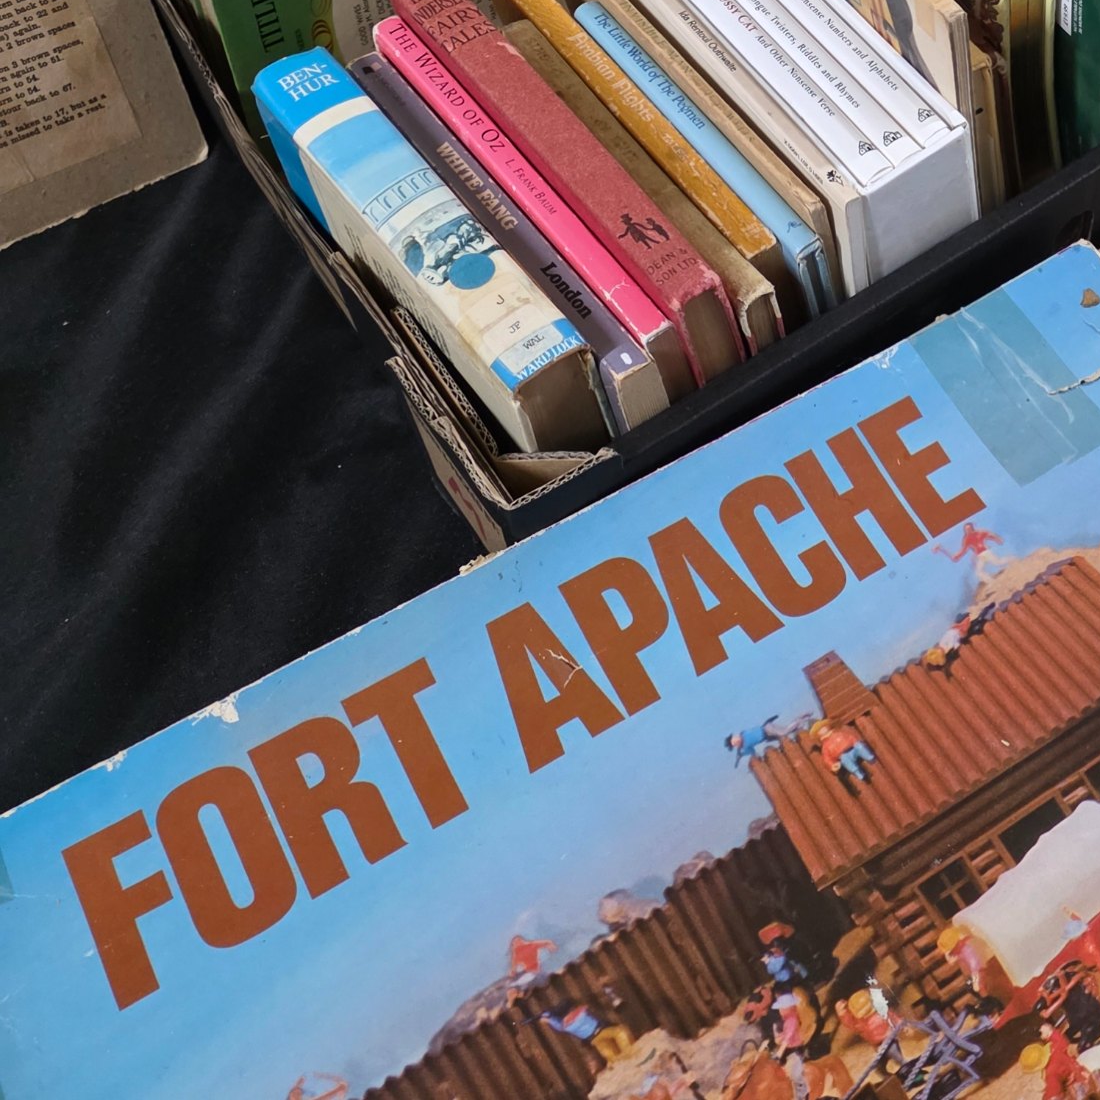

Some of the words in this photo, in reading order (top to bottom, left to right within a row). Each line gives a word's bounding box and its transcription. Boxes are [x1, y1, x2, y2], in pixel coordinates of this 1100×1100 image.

[51, 1, 70, 14] and
[426, 5, 484, 42] FAIRY
[16, 31, 45, 47] brown
[440, 19, 498, 54] TALES
[677, 9, 690, 23] Ida
[687, 18, 711, 45] Rentoul
[707, 39, 738, 73] Outhwaite
[20, 50, 51, 66] brown
[566, 31, 617, 80] Arabian
[594, 12, 611, 31] The
[607, 26, 632, 52] Little
[627, 43, 654, 73] World
[648, 65, 662, 83] of
[657, 75, 677, 97] The
[673, 93, 706, 131] Pegmen
[737, 13, 758, 34] CAT
[754, 33, 771, 49] And
[767, 46, 789, 70] Other
[786, 66, 818, 100] Nonsense
[817, 97, 837, 118] Verse
[769, 14, 797, 45] Twisters,
[796, 42, 823, 70] Riddles
[820, 67, 836, 84] and
[833, 80, 862, 110] Rhymes
[823, 17, 853, 50] Numbers
[851, 45, 868, 61] and
[865, 58, 900, 93] Alphabets
[276, 61, 330, 92] BEN-
[286, 73, 341, 103] HUR
[25, 94, 48, 107] back
[386, 21, 418, 54] THE
[413, 52, 466, 110] WIZARD
[462, 107, 485, 131] OF
[503, 157, 514, 167] L.
[512, 165, 539, 194] FRANK
[535, 187, 558, 217] BAUM
[434, 140, 481, 194] WHITE
[475, 187, 520, 233] FANG
[647, 253, 678, 277] DEAN
[656, 268, 679, 287] SON
[495, 293, 506, 306] J
[539, 260, 594, 321] London
[507, 320, 523, 336] JF
[522, 331, 546, 352] WAL
[60, 656, 470, 1011] FORT
[485, 394, 988, 775] APACHE
